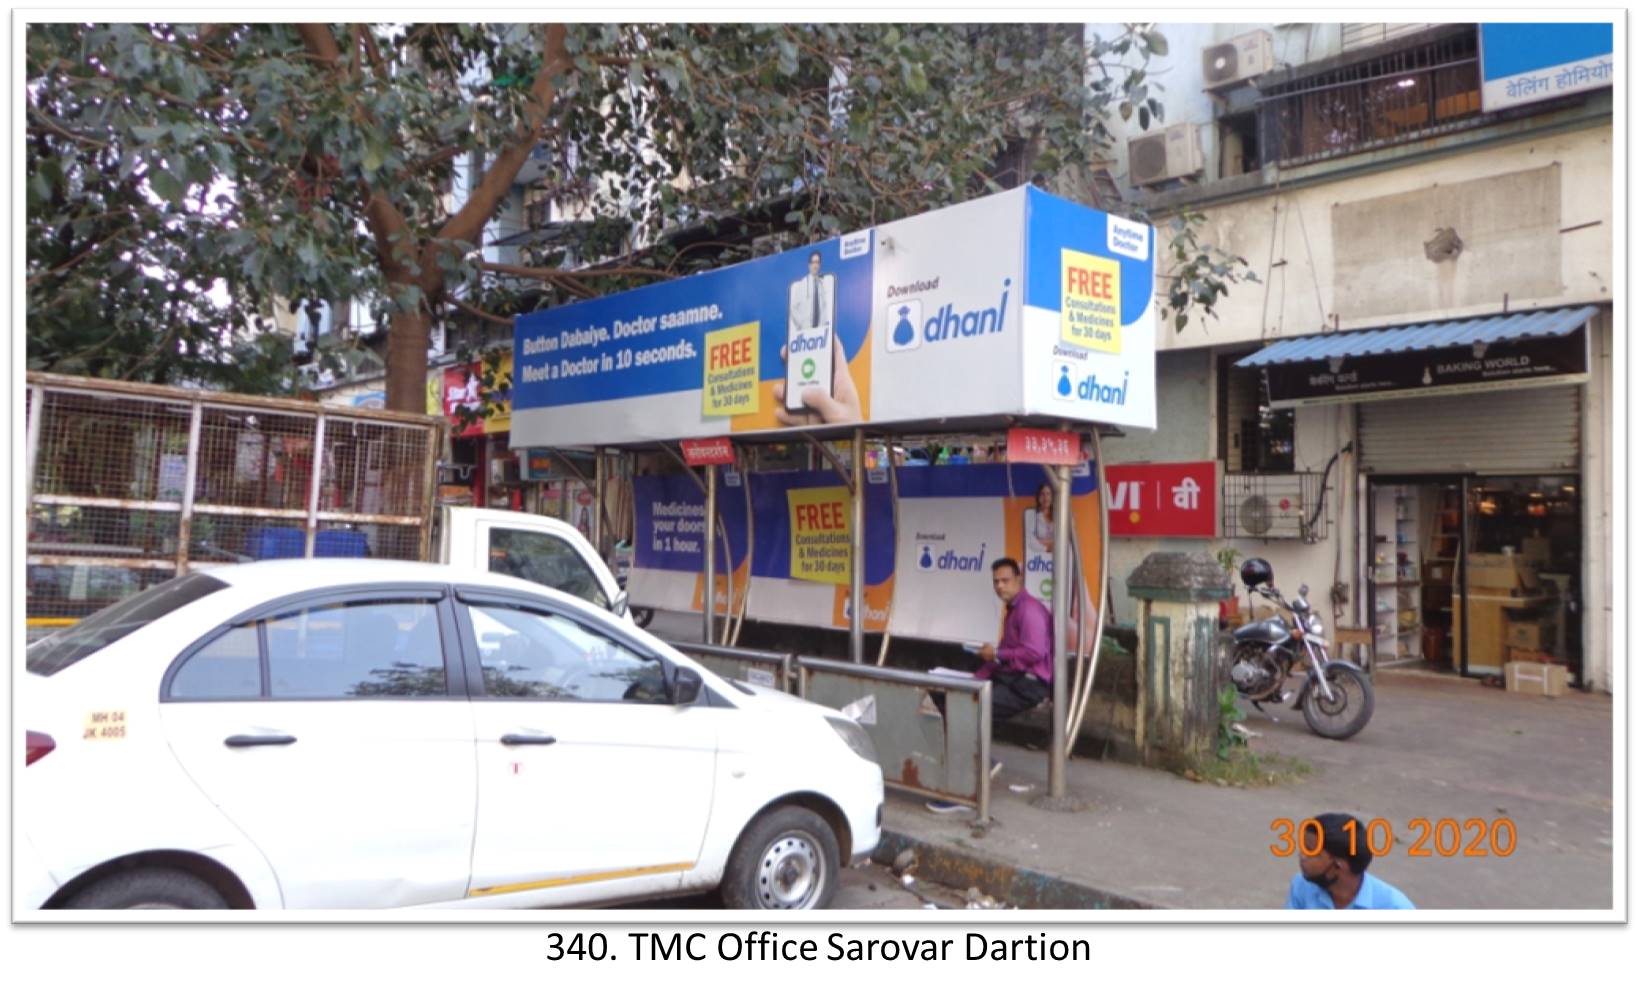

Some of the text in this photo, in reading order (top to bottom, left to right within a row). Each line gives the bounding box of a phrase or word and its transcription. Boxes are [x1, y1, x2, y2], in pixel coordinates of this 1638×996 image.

[887, 276, 940, 299] Download
[1068, 266, 1113, 300] FREE
[924, 278, 1011, 343] dhani
[1065, 296, 1117, 315] Consultations
[1068, 310, 1114, 328] & Medicines
[523, 303, 724, 356] Button Dabaiye. Doctor saamne.
[1071, 325, 1112, 343] for 30 days
[522, 338, 697, 383] Meet a Doctor in 10 seconds.
[710, 338, 752, 371] FREE
[1052, 345, 1089, 361] Download
[1437, 355, 1531, 374] BAKING WORLD
[707, 366, 755, 385] Consultations
[717, 380, 753, 396] Medicines
[1077, 370, 1130, 406] dhani
[712, 398, 721, 408] for
[733, 393, 750, 407] days
[1172, 477, 1200, 510] वी
[652, 501, 705, 517] Medicines
[795, 502, 845, 530] FREE
[653, 521, 675, 534] your
[653, 535, 701, 552] in 1 hour.
[795, 533, 850, 545] Consultations
[806, 547, 848, 558] Medicines
[937, 543, 986, 572] dhani
[802, 559, 845, 573] for 30 days
[111, 711, 125, 723] 04
